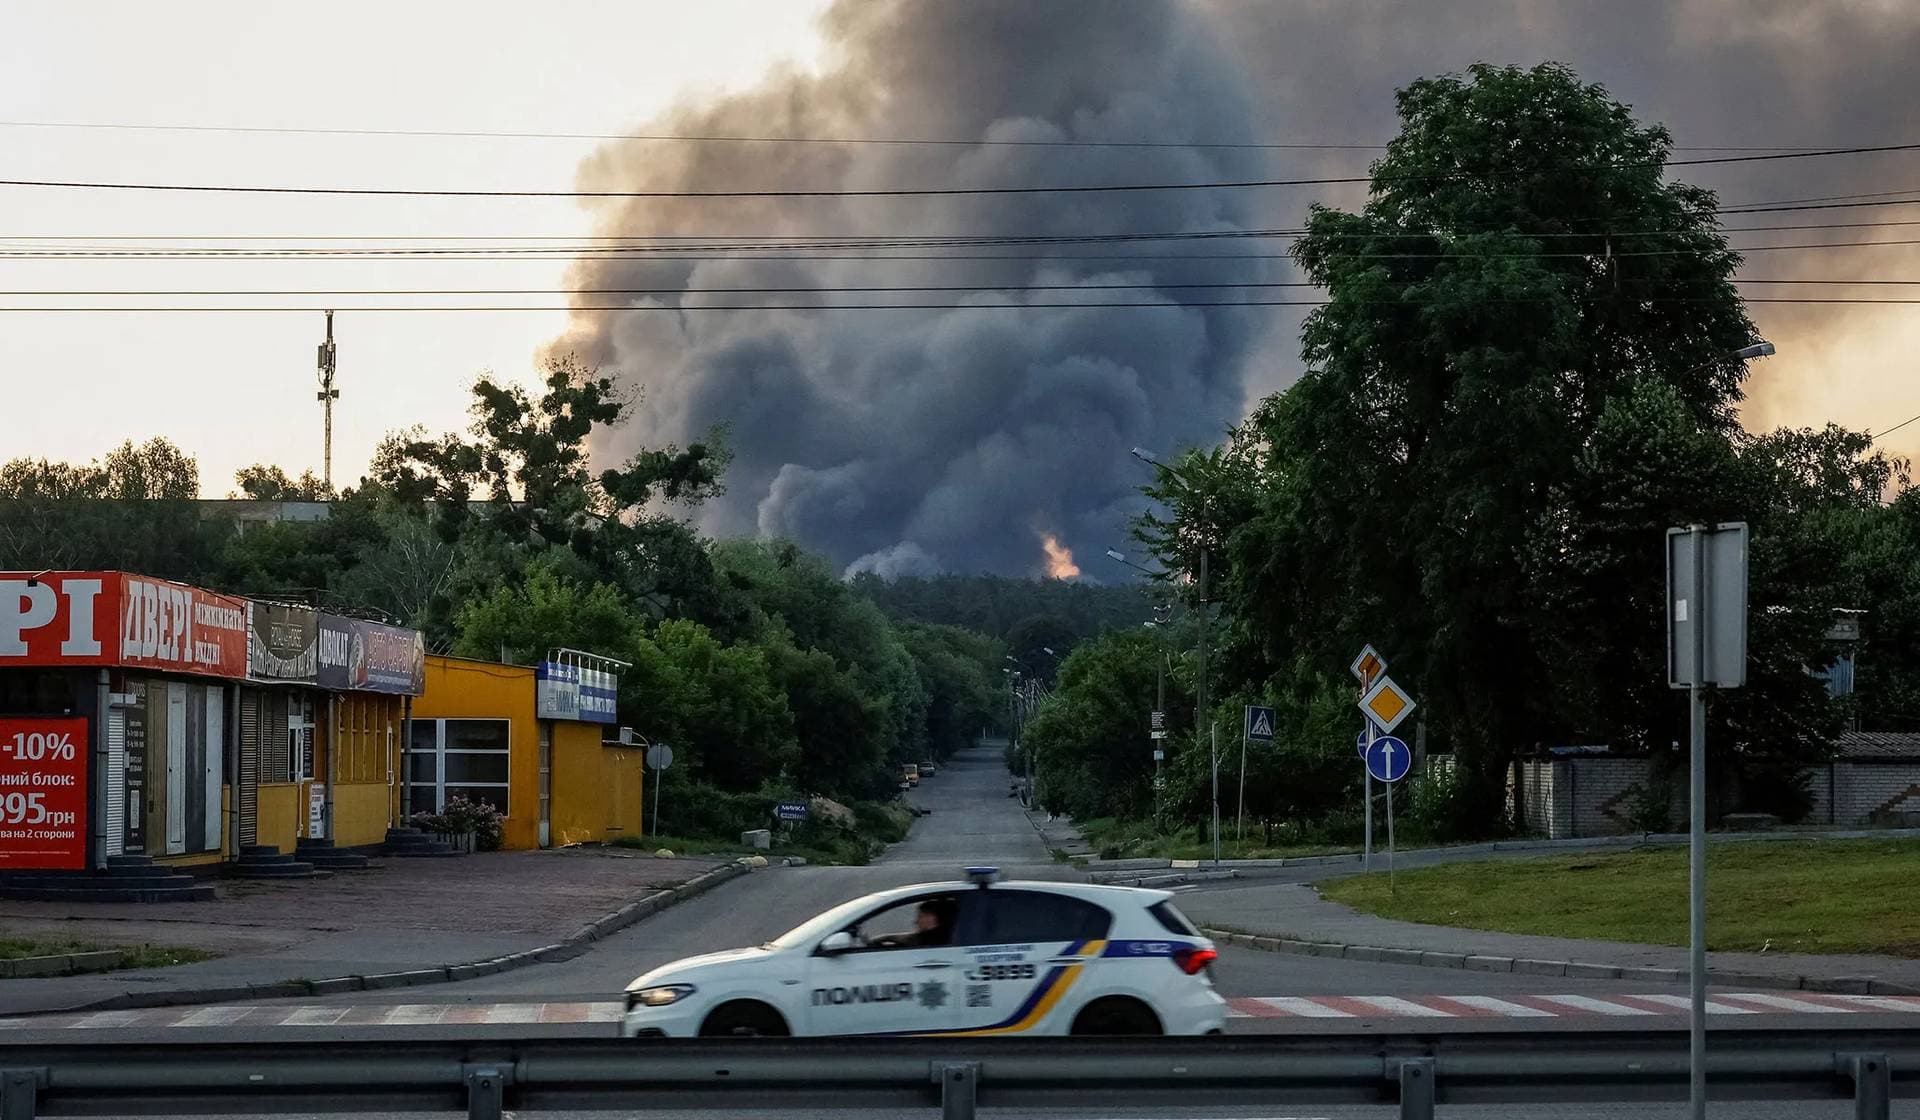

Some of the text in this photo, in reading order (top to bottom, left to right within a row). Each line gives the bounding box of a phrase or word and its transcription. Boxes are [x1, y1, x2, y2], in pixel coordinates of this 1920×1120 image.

[123, 580, 192, 661] ДВЕРІ
[194, 592, 247, 632] міжкімнатні
[195, 632, 220, 669] вхідні
[319, 628, 349, 669] АДВОКАТ
[2, 732, 75, 761] -10%
[0, 771, 75, 786] ний блок:
[0, 792, 75, 827] 95 грн
[13, 829, 26, 838] на
[27, 828, 34, 838] 2
[34, 829, 75, 840] сторони
[812, 982, 913, 1006] ПОЛІЦІЯ
